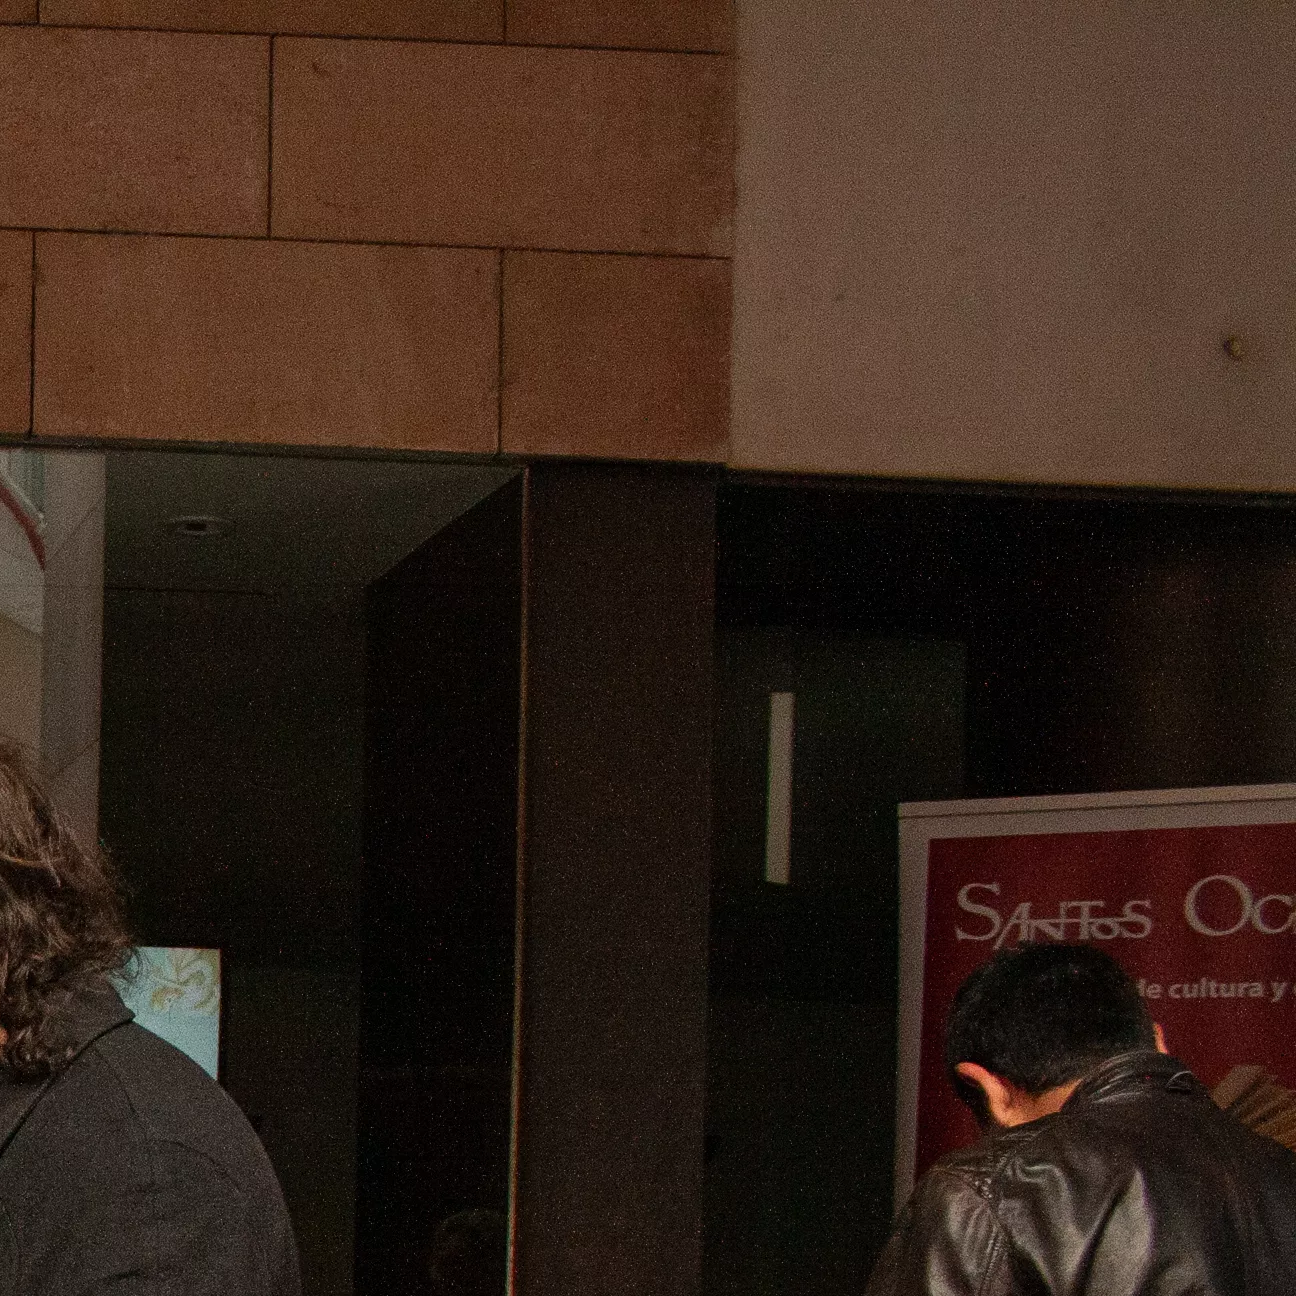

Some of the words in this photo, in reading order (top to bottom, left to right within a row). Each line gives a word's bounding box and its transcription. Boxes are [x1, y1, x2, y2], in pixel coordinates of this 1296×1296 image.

[1184, 874, 1296, 936] OC
[1168, 978, 1264, 1000] cultura
[1269, 983, 1288, 1003] y
